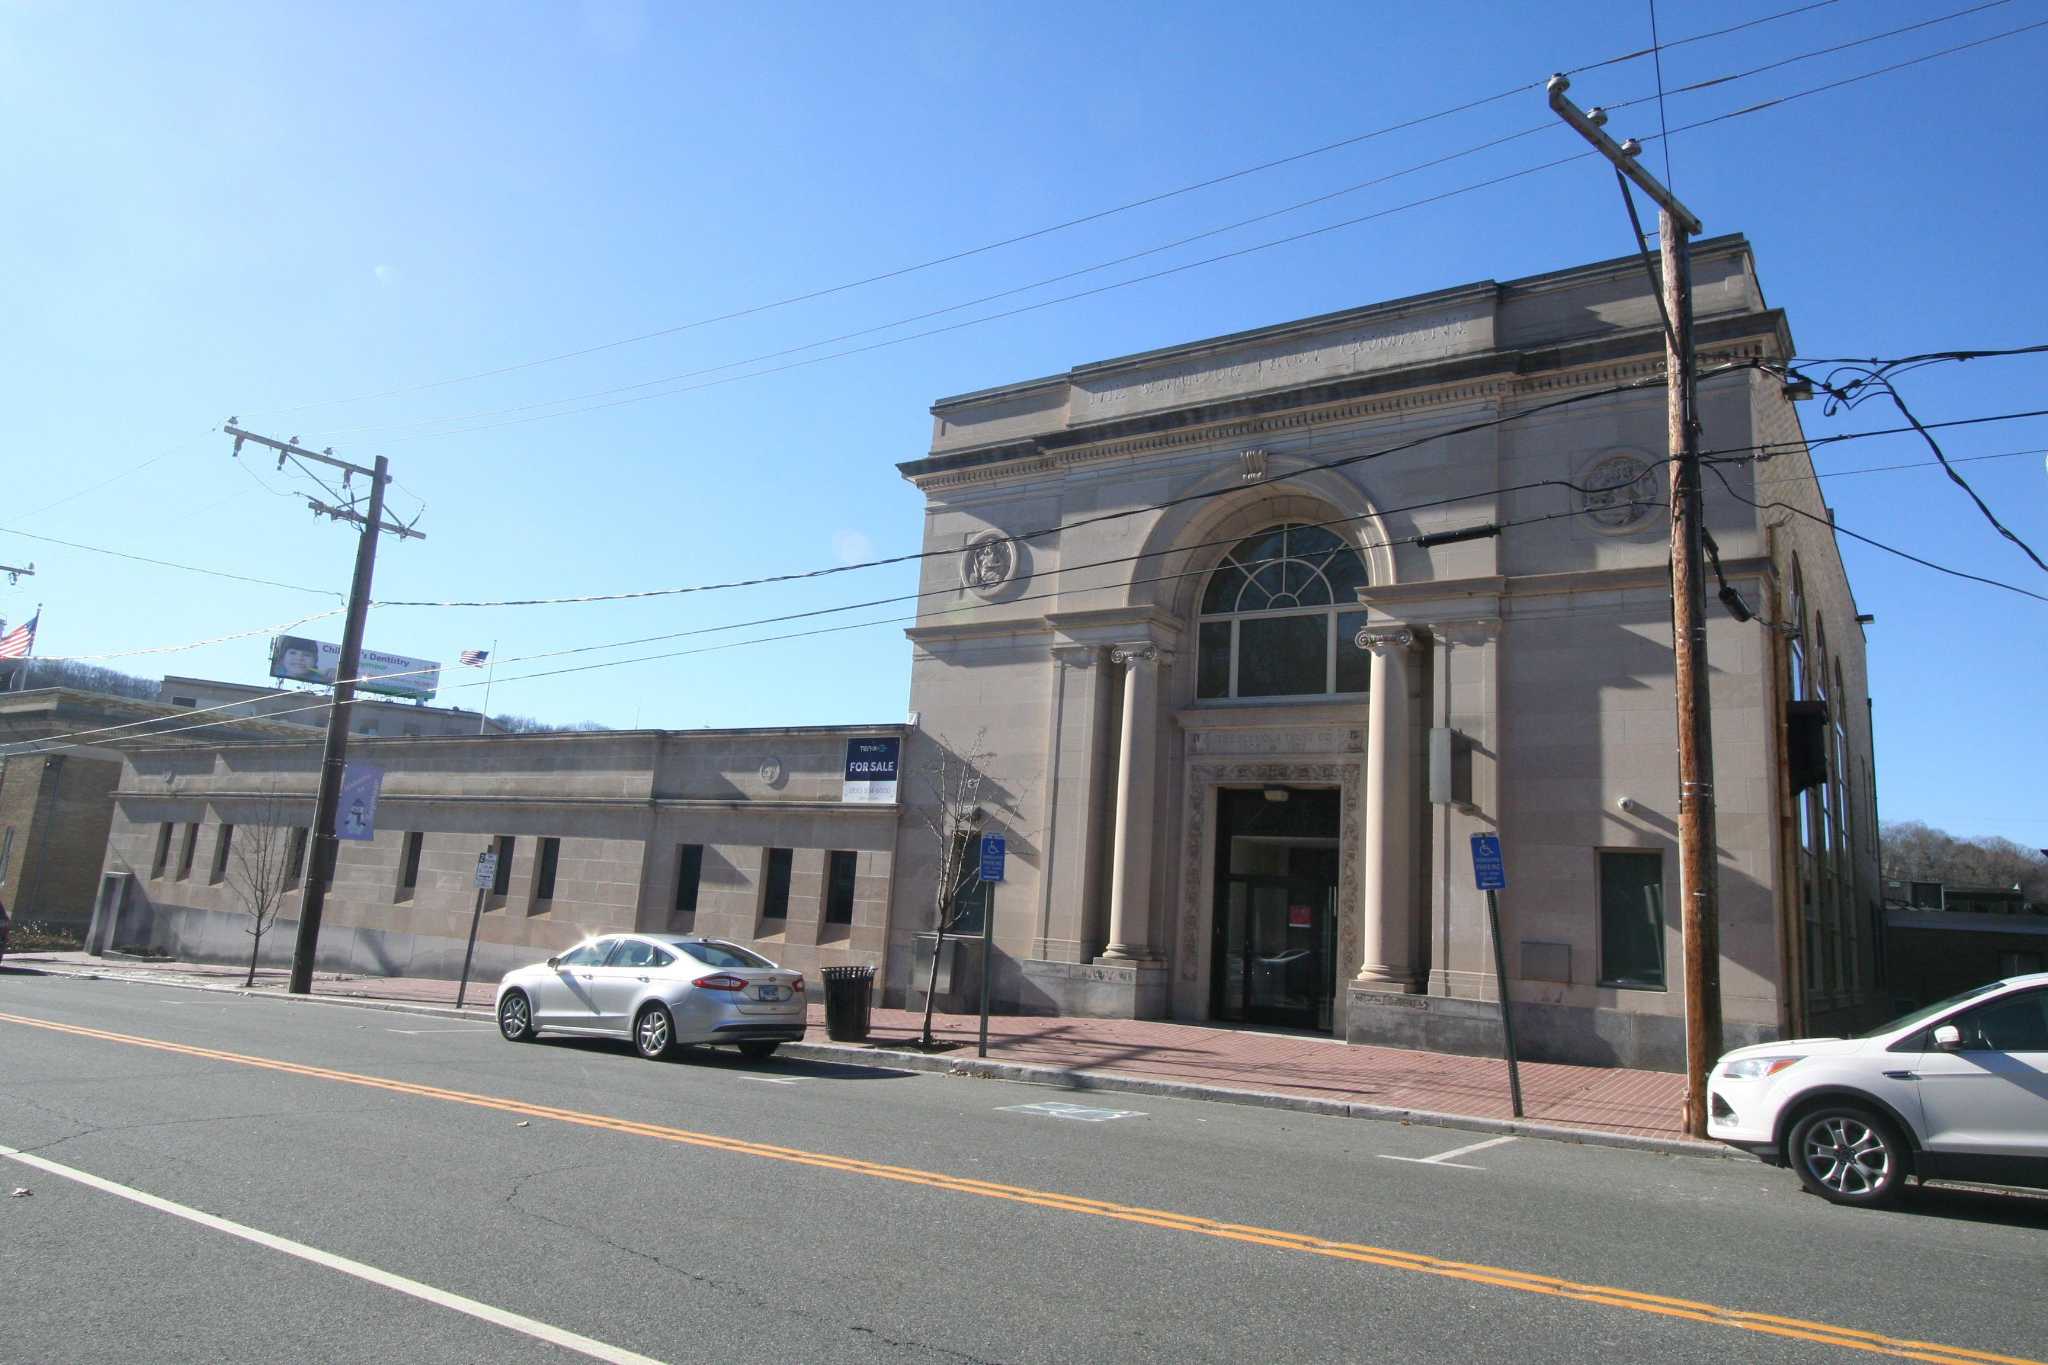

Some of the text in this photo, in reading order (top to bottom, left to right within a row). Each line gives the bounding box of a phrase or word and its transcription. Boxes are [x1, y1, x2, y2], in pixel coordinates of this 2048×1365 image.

[322, 645, 367, 659] Chil's
[370, 653, 410, 667] Dentistry
[849, 761, 895, 772] FOR SALE
